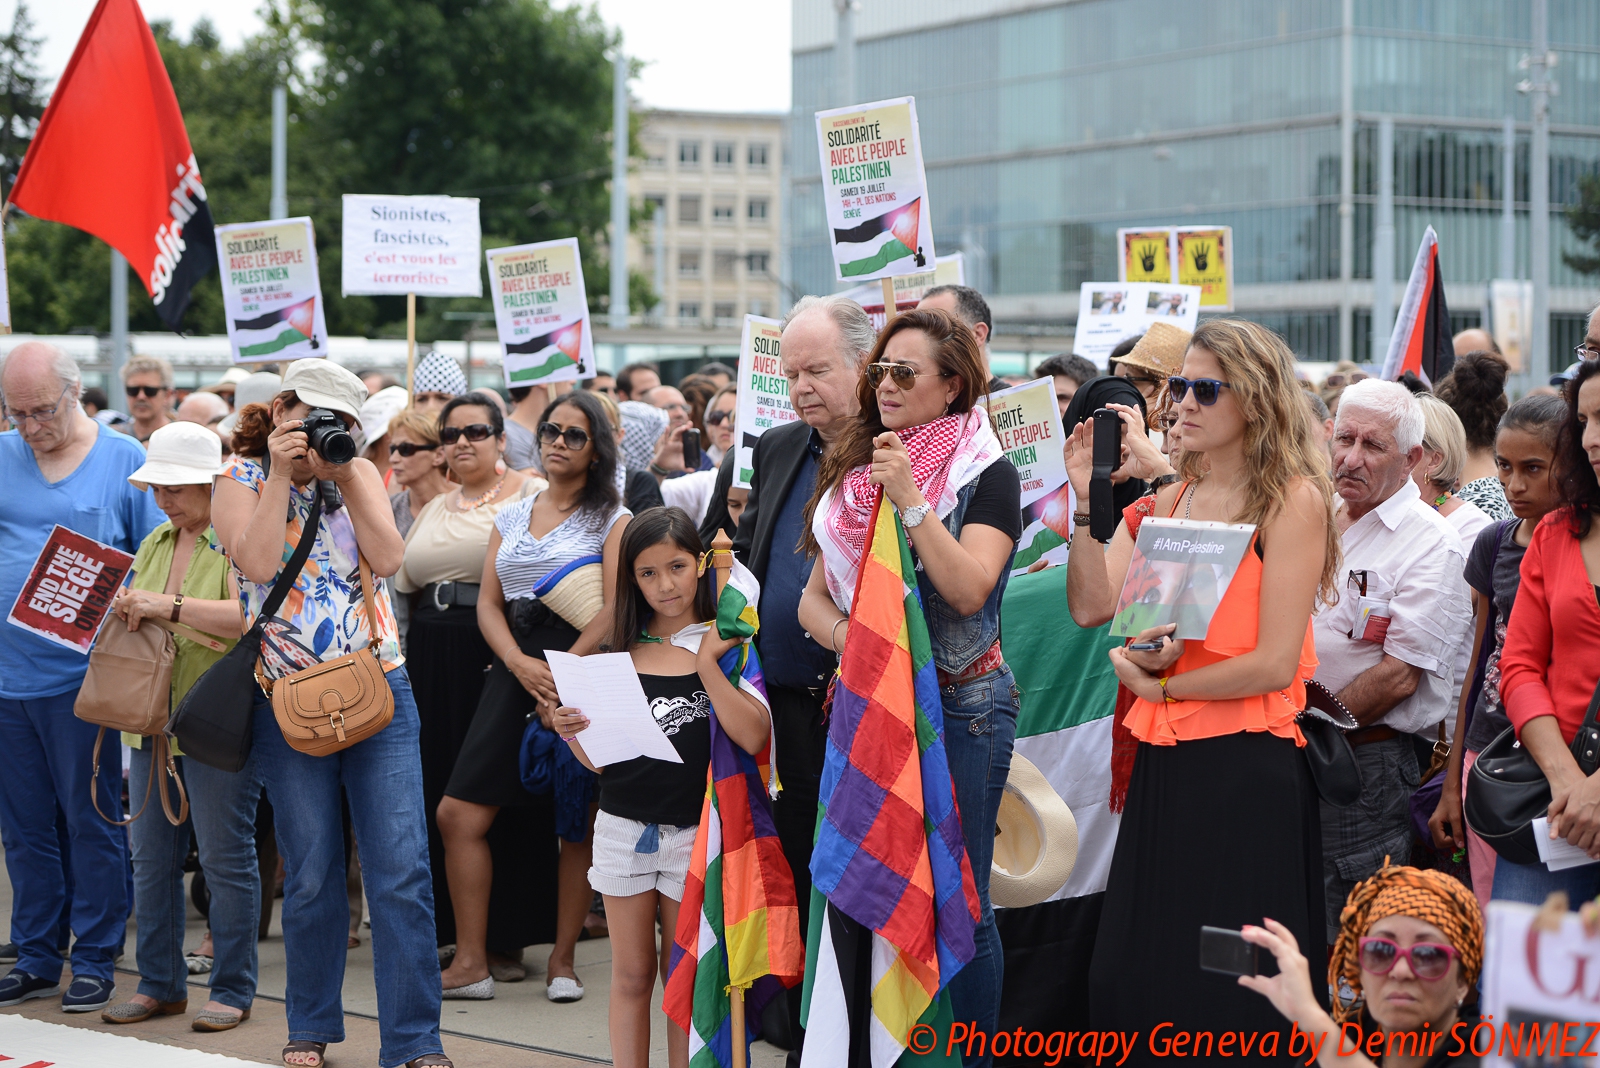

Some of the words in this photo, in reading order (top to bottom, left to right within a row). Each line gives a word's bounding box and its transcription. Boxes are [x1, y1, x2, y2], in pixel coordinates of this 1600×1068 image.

[828, 120, 881, 148] SOLIDARITÉ
[831, 147, 855, 166] AVEC
[857, 145, 868, 162] LE
[870, 139, 906, 160] PEUPLE
[832, 160, 891, 185] PALESTINIEN
[841, 187, 859, 197] SAMEDI
[860, 186, 866, 194] 19
[867, 183, 885, 193] JUILLET
[842, 199, 851, 208] 14H
[856, 197, 864, 206] PL.
[865, 195, 874, 205] DES
[875, 192, 896, 203] NATIONS
[371, 205, 451, 223] Sionistes,
[843, 208, 861, 219] GENÈVE
[227, 235, 279, 255] SOLIDARITÉ
[374, 229, 449, 246] fascistes,
[230, 254, 254, 270] AVEC
[256, 253, 267, 267] LE
[269, 249, 303, 266] PEUPLE
[364, 251, 397, 264] c'est
[402, 255, 434, 264] vous
[439, 253, 457, 265] les
[499, 257, 549, 278] SOLIDARITÉ
[231, 266, 289, 285] PALESTINIEN
[373, 271, 449, 285] terroristes
[502, 279, 524, 293] AVEC
[526, 276, 537, 291] LE
[538, 271, 571, 288] PEUPLE
[503, 289, 558, 308] PALESTINIEN
[754, 337, 781, 357] SOLID
[753, 356, 776, 375] AVEC
[779, 360, 788, 377] L
[757, 396, 775, 407] SAMEDI
[777, 400, 781, 408] 19
[757, 407, 765, 416] 14H
[779, 411, 788, 420] DES
[1000, 432, 1012, 450] LE
[1013, 421, 1051, 447] PEUPLE
[1022, 479, 1044, 492] NATIONS
[1153, 538, 1224, 554] #IAmPalestine
[28, 577, 60, 614] END
[46, 545, 78, 578] THE
[49, 552, 105, 624] SIEGE
[74, 606, 100, 631] ON
[88, 566, 123, 607] GAZA
[1524, 908, 1600, 1004] G
